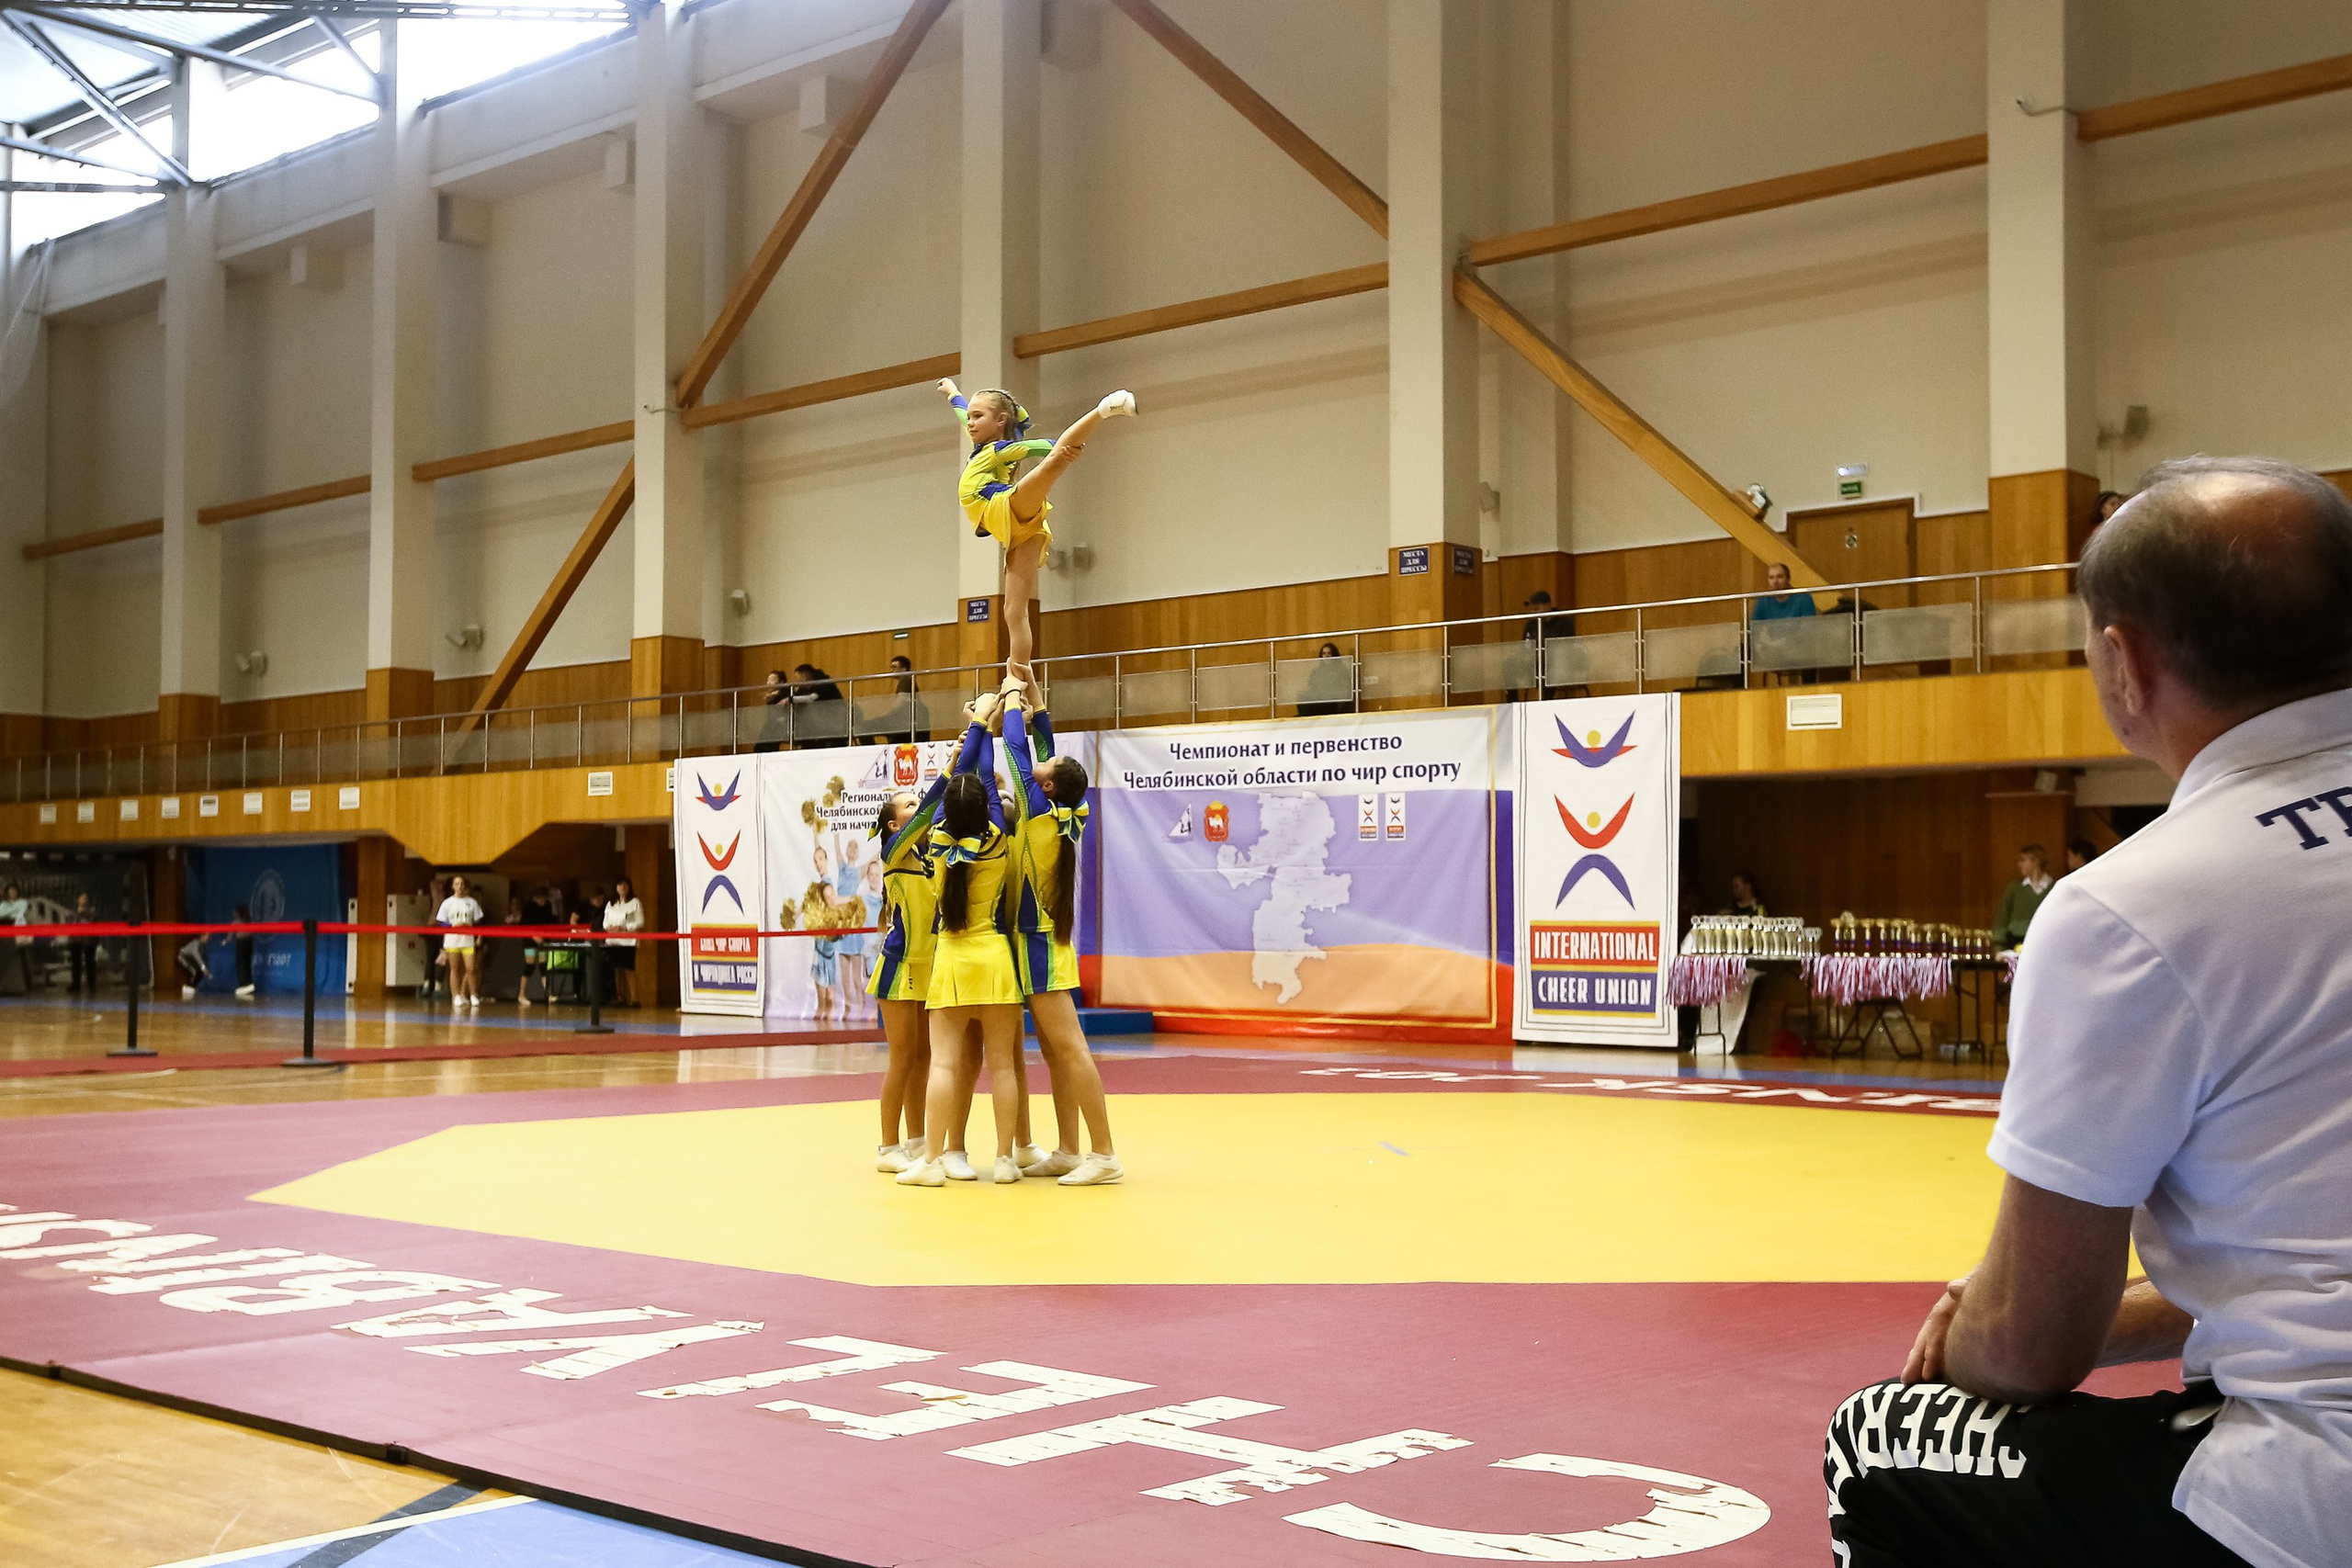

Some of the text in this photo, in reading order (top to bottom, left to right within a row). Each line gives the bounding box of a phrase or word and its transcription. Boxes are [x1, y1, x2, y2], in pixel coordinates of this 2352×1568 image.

[1170, 736, 1403, 761] Чемпионат и первенство
[1124, 762, 1462, 789] Челябинской области по чир спорту
[1533, 931, 1657, 962] INTERNATIONAL
[1537, 976, 1652, 1006] CHEER UNION
